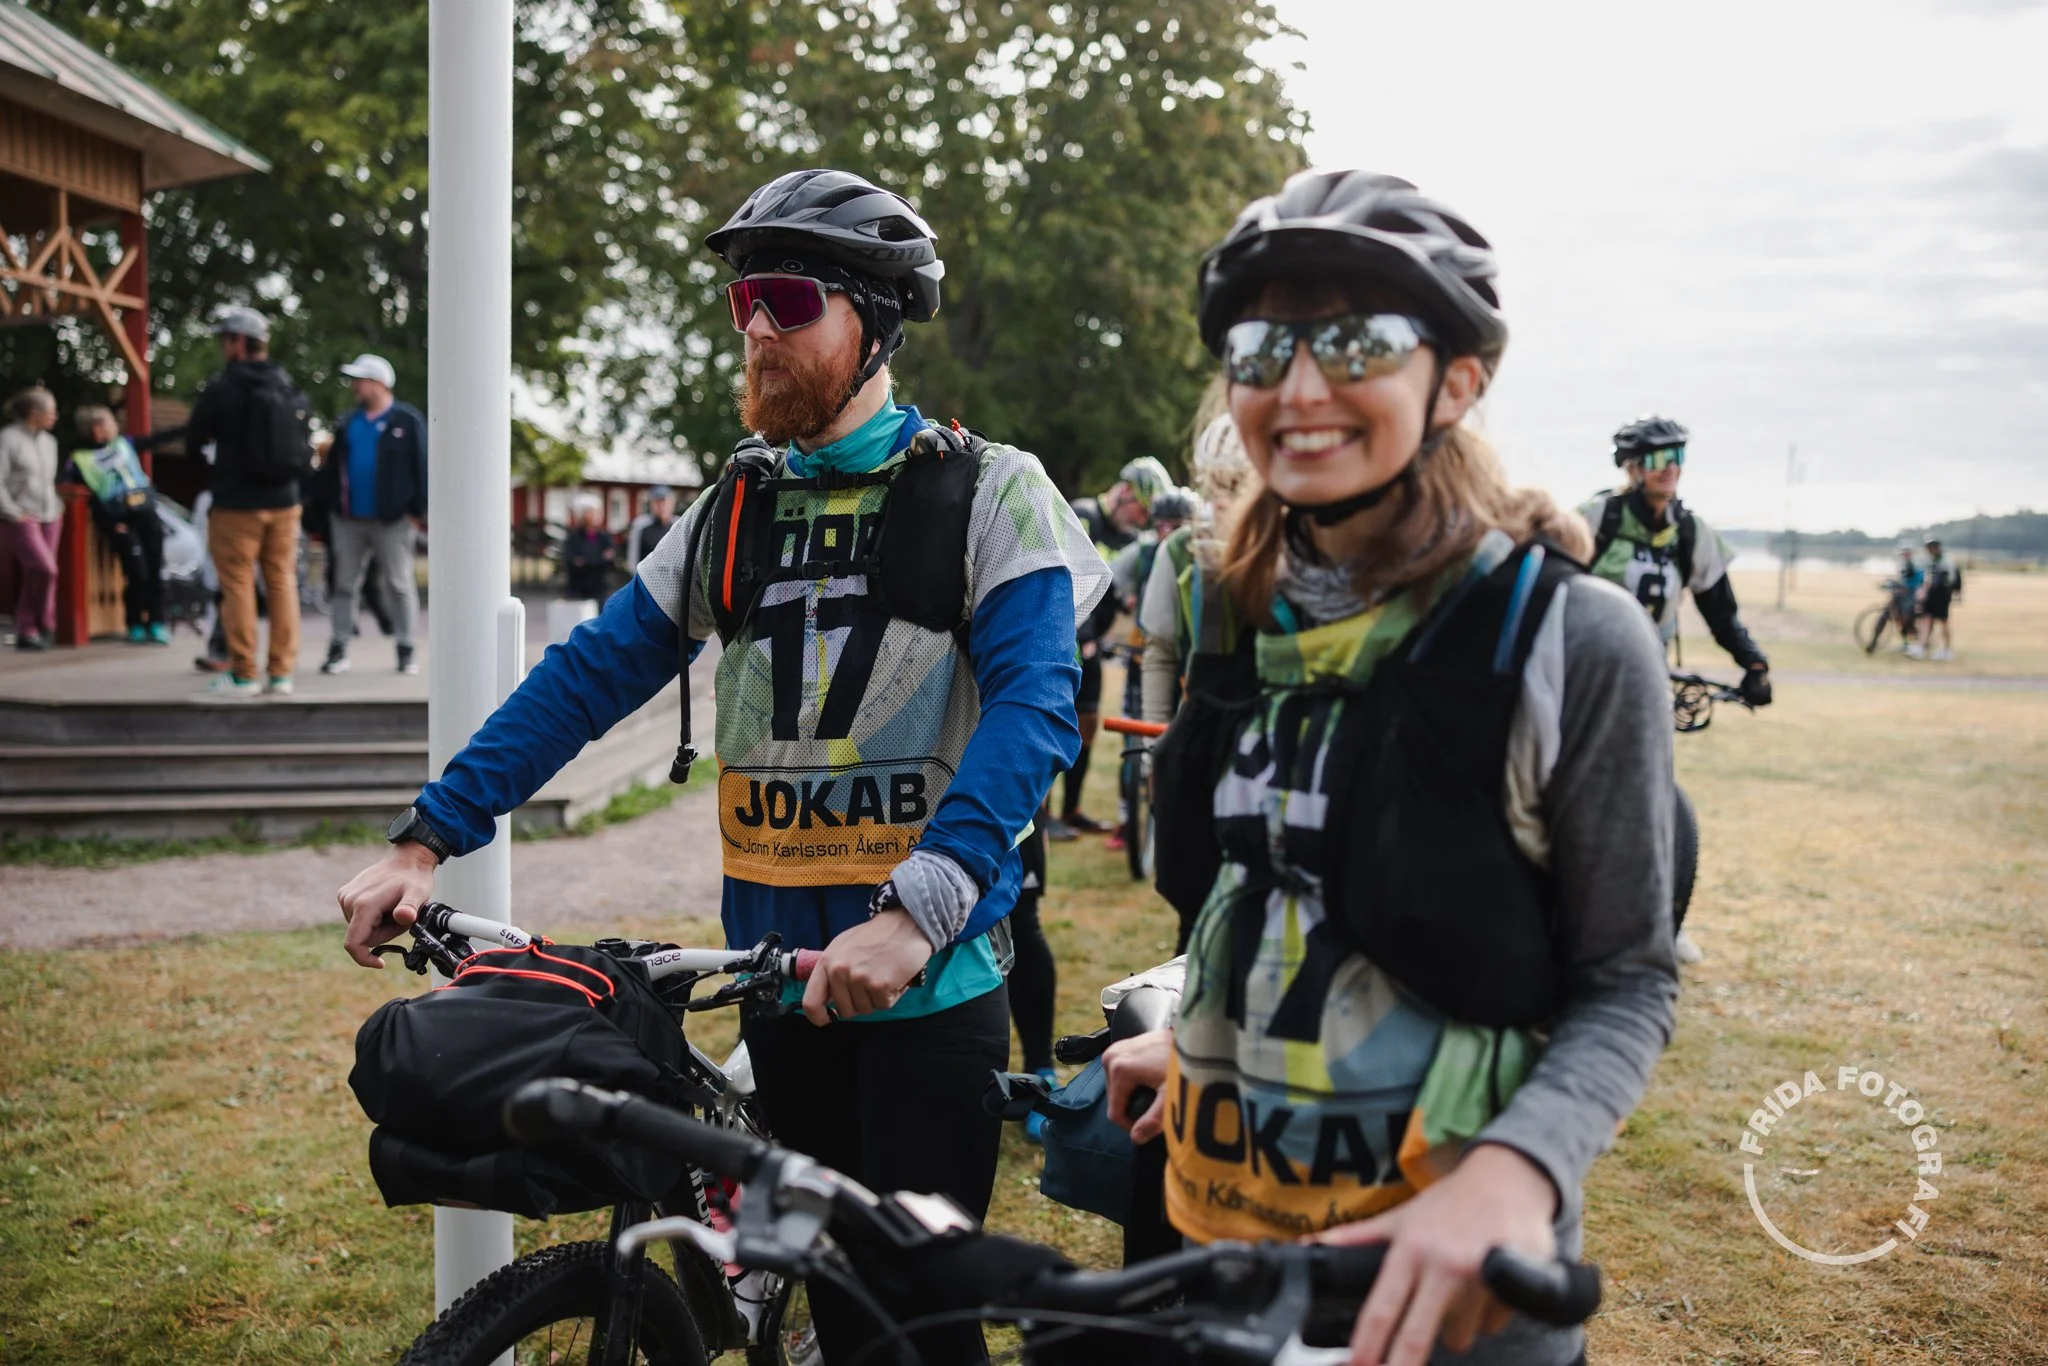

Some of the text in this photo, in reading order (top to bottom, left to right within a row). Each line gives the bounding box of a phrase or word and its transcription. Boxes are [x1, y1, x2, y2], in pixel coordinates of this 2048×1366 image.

[750, 593, 892, 742] 17
[735, 773, 928, 830] JOKAB
[742, 838, 769, 854] John
[774, 841, 848, 858] Karlsson
[855, 834, 899, 856] Åkeri
[1167, 1075, 1413, 1187] JOKA
